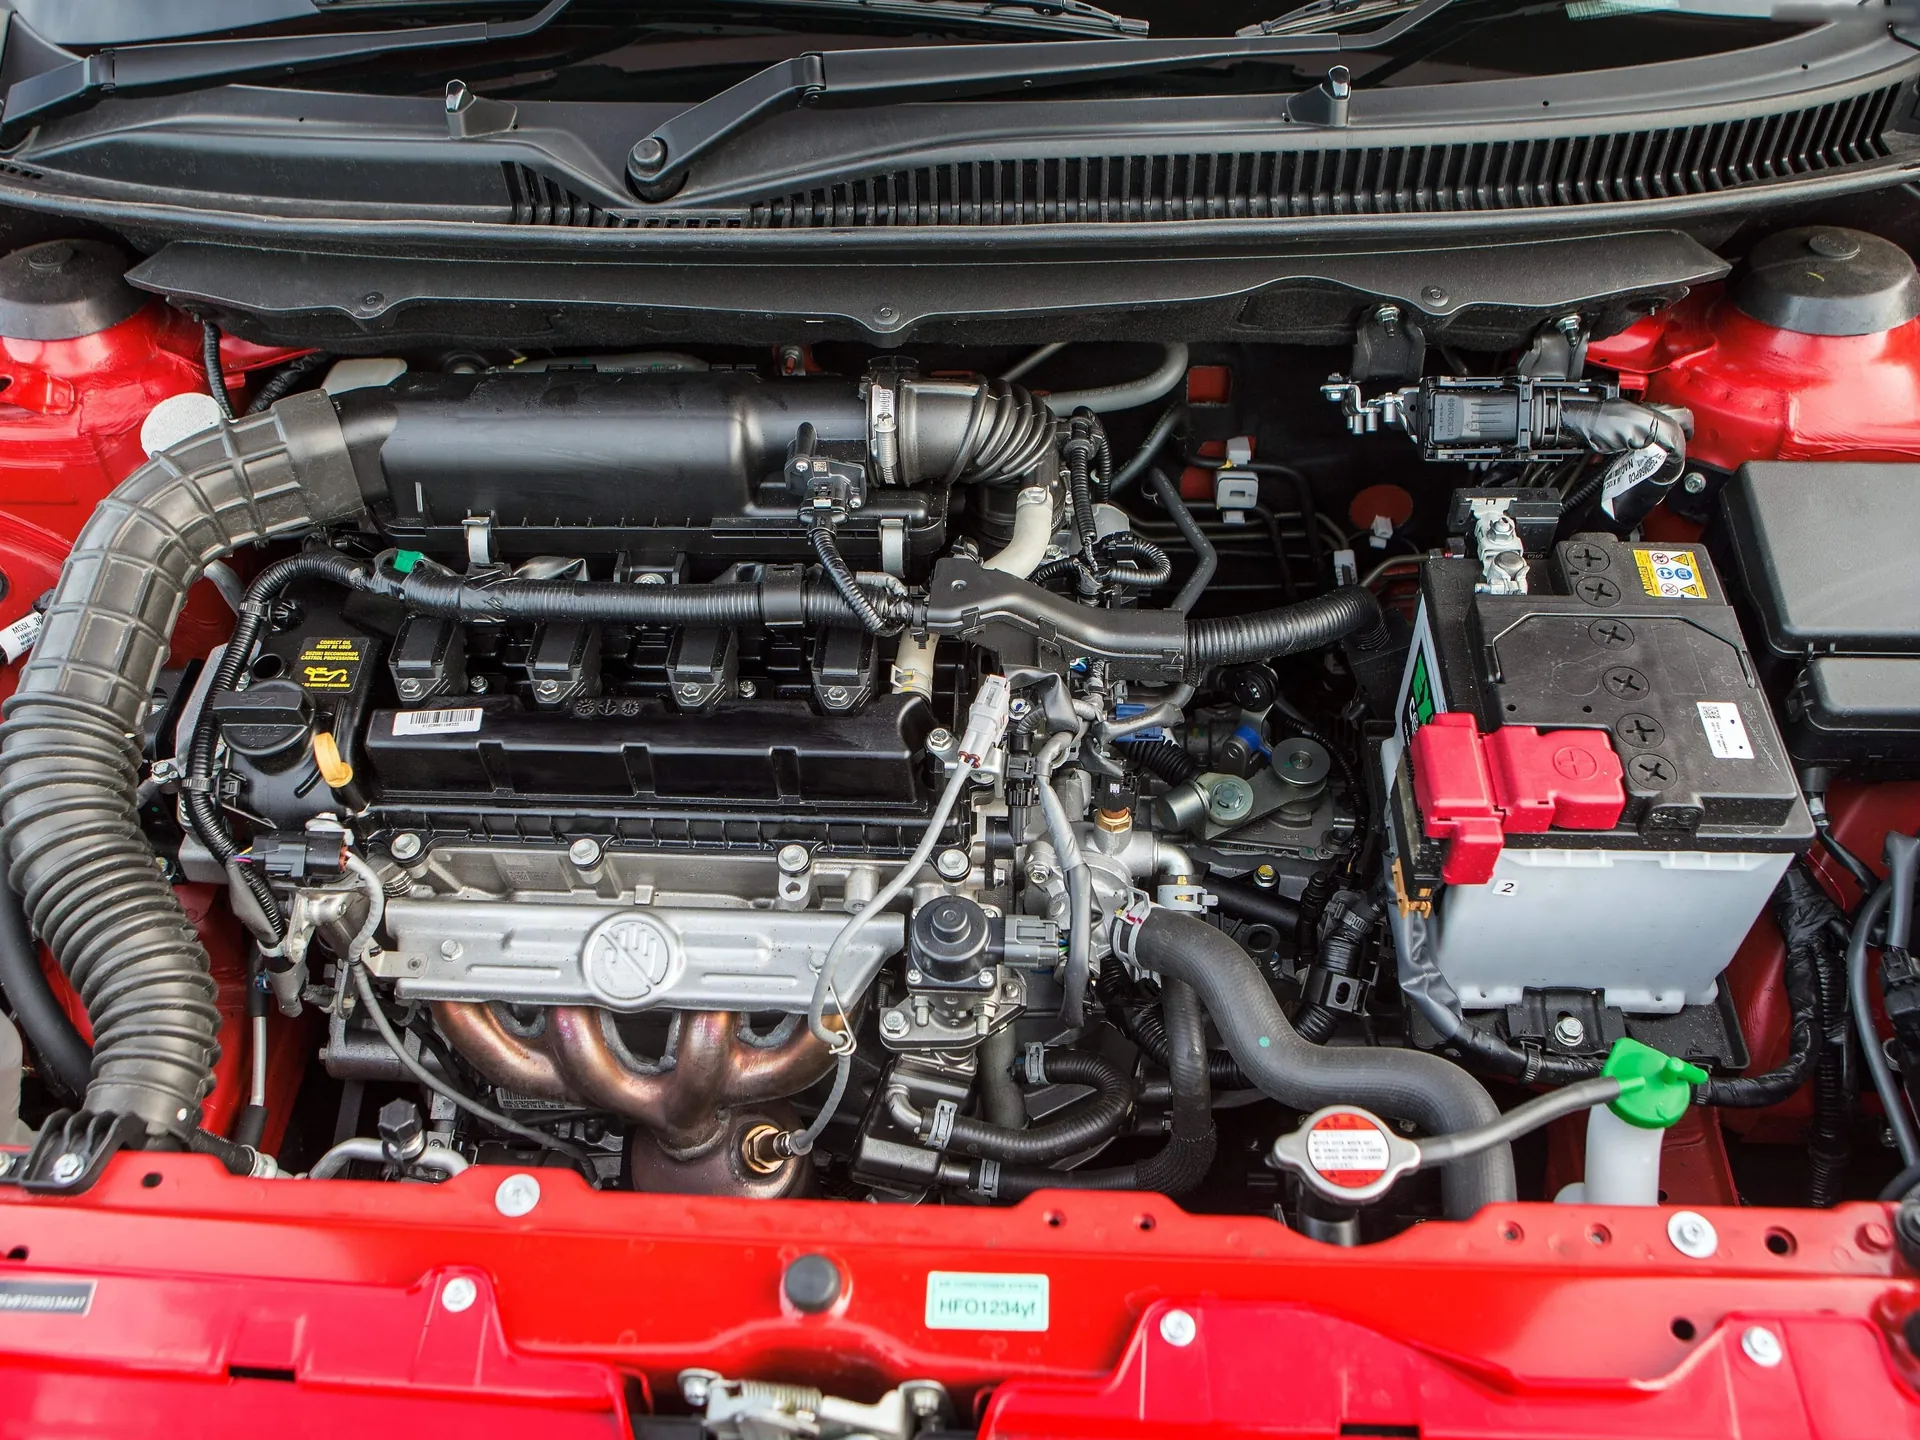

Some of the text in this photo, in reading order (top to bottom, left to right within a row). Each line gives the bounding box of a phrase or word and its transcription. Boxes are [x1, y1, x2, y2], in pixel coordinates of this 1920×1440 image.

[12, 621, 31, 635] MSSL
[239, 726, 283, 737] ENGINE
[248, 737, 265, 748] OIL
[1500, 882, 1515, 893] 2
[939, 1298, 1037, 1319] HFO1234yf
